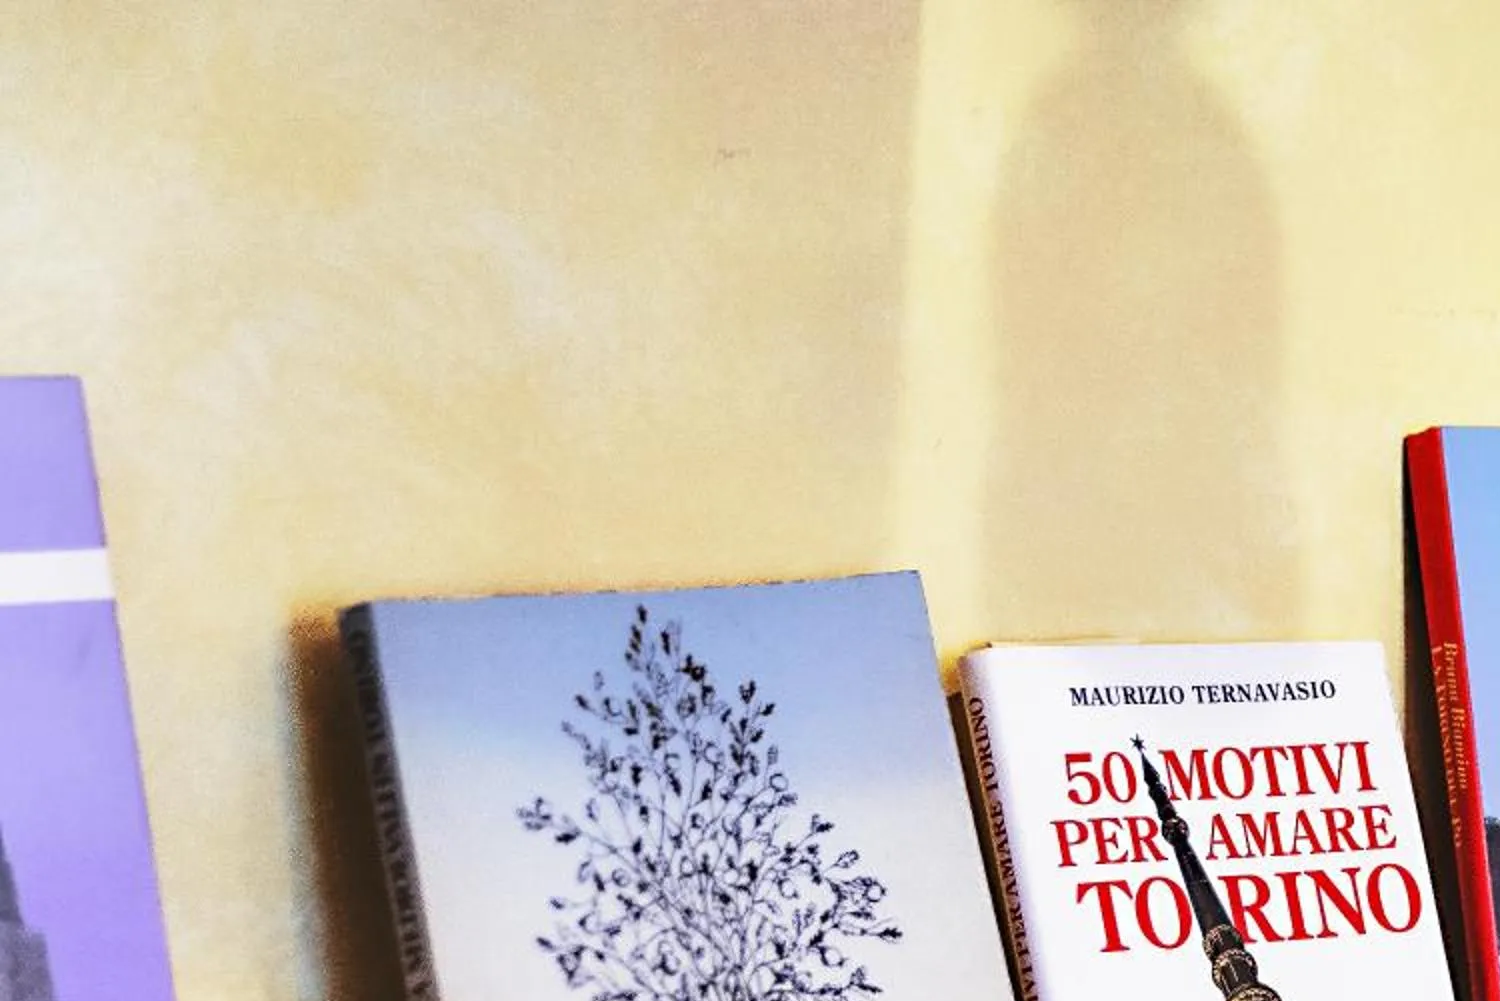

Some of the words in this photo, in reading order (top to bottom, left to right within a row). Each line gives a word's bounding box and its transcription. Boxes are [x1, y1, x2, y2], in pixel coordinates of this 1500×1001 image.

[1069, 684, 1186, 707] MAURIZIO
[1191, 679, 1337, 704] TERNAVASIO
[969, 696, 999, 791] TORINO
[1063, 750, 1137, 805] 50
[1158, 740, 1379, 801] MOTIVI
[1049, 815, 1168, 868] PER
[1205, 804, 1399, 861] AMARE
[1076, 862, 1423, 954] TORINO
